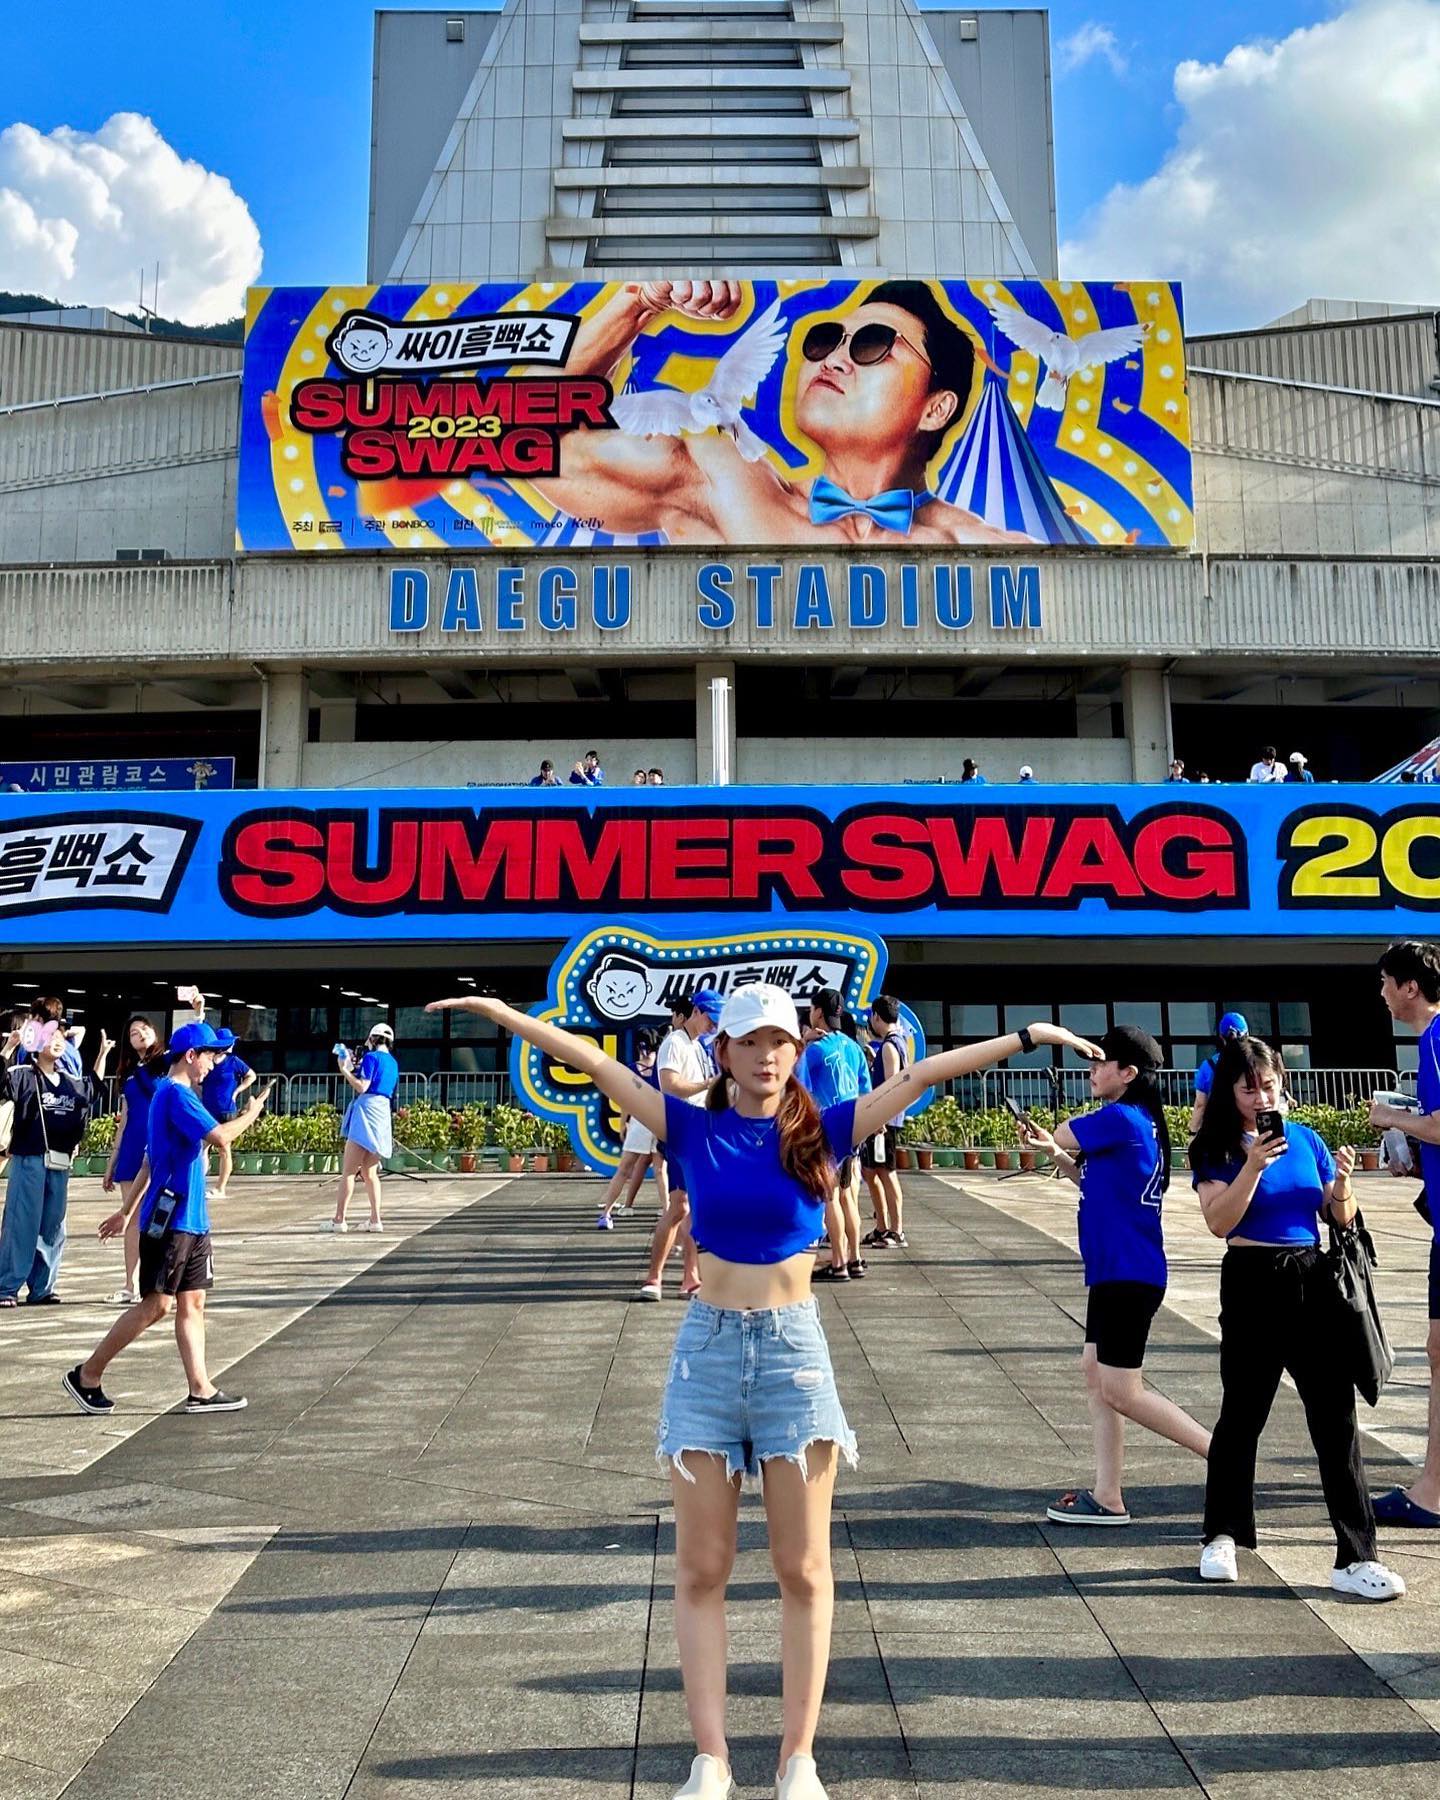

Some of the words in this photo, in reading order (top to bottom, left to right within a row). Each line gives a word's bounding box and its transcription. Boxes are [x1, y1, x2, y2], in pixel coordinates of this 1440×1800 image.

[396, 323, 555, 362] 싸이흠뻑쇼
[295, 381, 607, 428] SUMMER
[407, 415, 502, 439] 2023
[346, 427, 554, 475] SWAG
[292, 520, 313, 532] 주최
[364, 520, 386, 532] 주관
[388, 565, 631, 632] DAEGU
[696, 564, 1043, 630] STADIUM
[30, 765, 167, 786] 시민관람코스
[0, 832, 156, 896] 흠뻑쇼
[231, 817, 825, 905] SUMMER
[840, 815, 1237, 900] SWAG
[1290, 816, 1440, 899] 20
